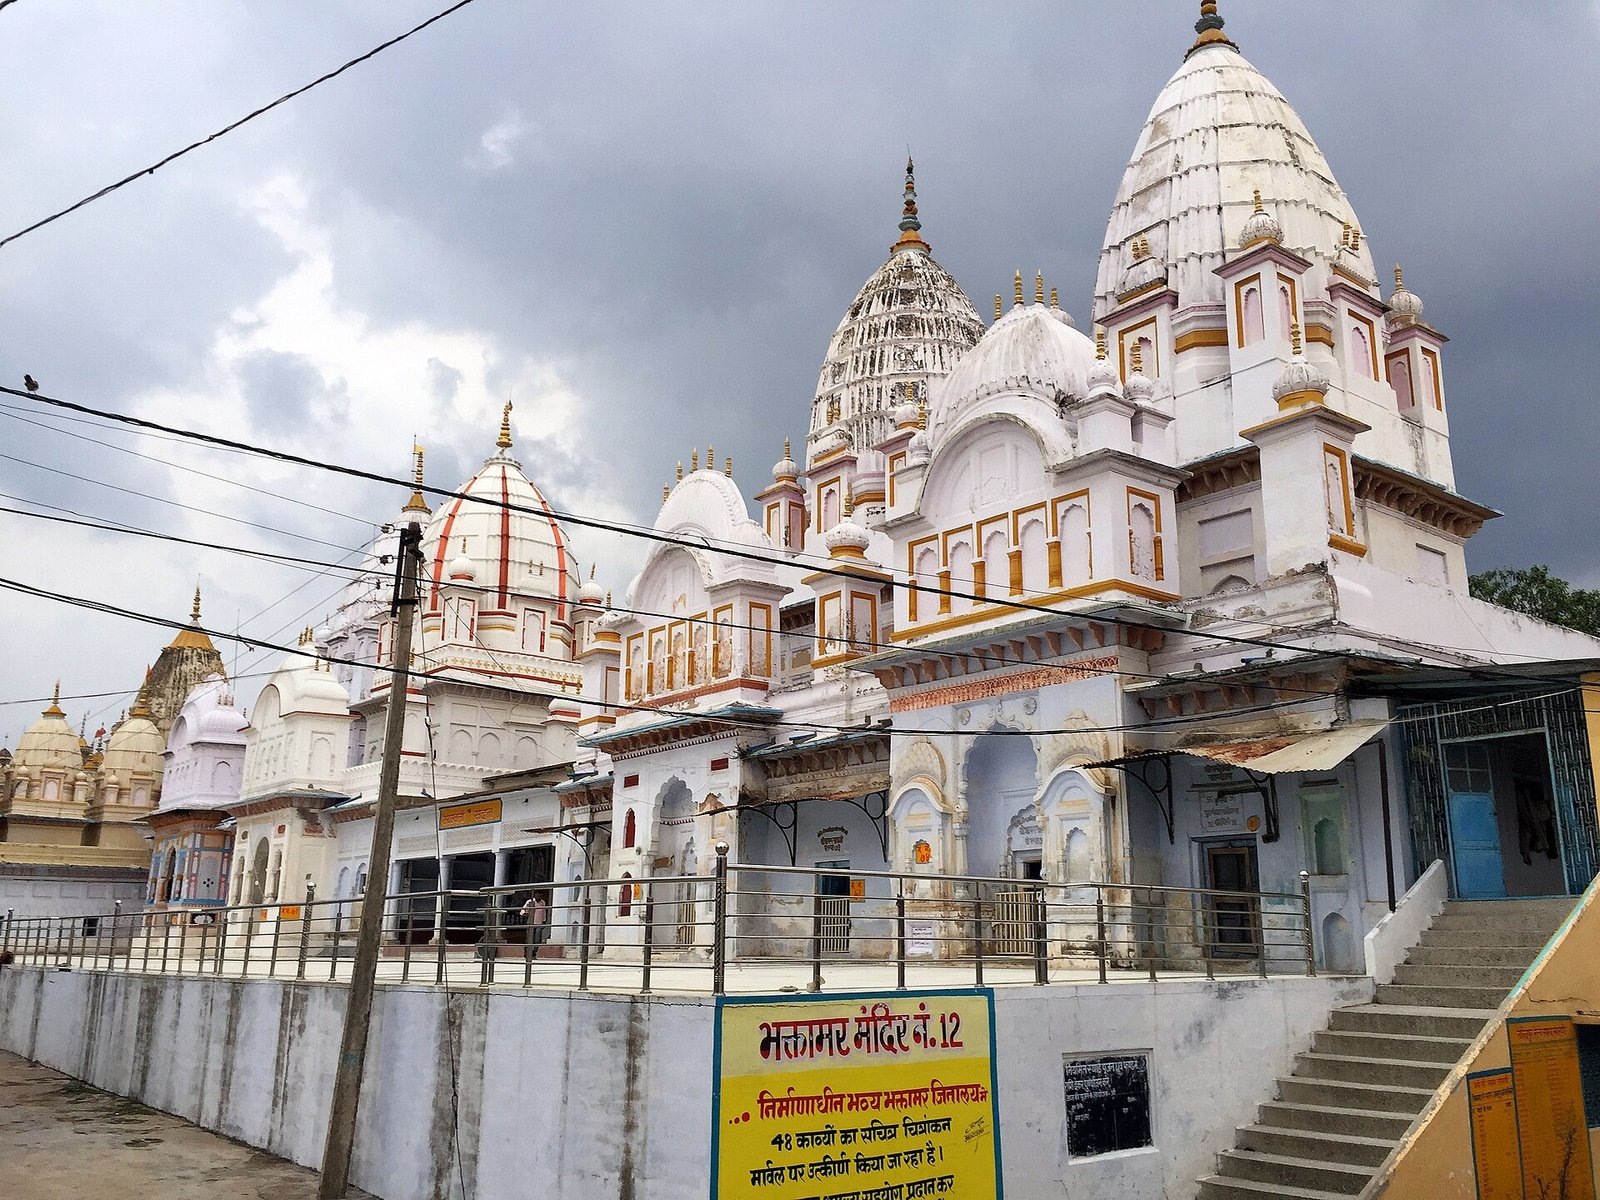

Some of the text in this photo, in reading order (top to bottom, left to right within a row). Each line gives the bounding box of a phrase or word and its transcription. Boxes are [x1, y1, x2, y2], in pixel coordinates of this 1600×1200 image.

[759, 1017, 850, 1061] भक्तामर
[854, 1002, 909, 1053] मंदिर
[940, 1012, 963, 1048] 12
[757, 1086, 846, 1119] निर्माणाधीन
[847, 1091, 881, 1112] भव्य
[883, 1088, 930, 1113] भक्तामर
[930, 1079, 980, 1105] जिनालय
[771, 1133, 792, 1151] 48
[794, 1124, 837, 1148] काव्यों
[839, 1126, 858, 1146] का
[860, 1119, 899, 1144] सचित्र
[903, 1114, 952, 1138] चित्रांकन
[787, 1164, 805, 1183] पर
[807, 1152, 851, 1181] उत्कीर्ण
[853, 1152, 885, 1174] किया
[886, 1152, 901, 1169] जा
[902, 1149, 923, 1171] रहा
[905, 1178, 936, 1199] प्रदान
[937, 1175, 954, 1193] कर
